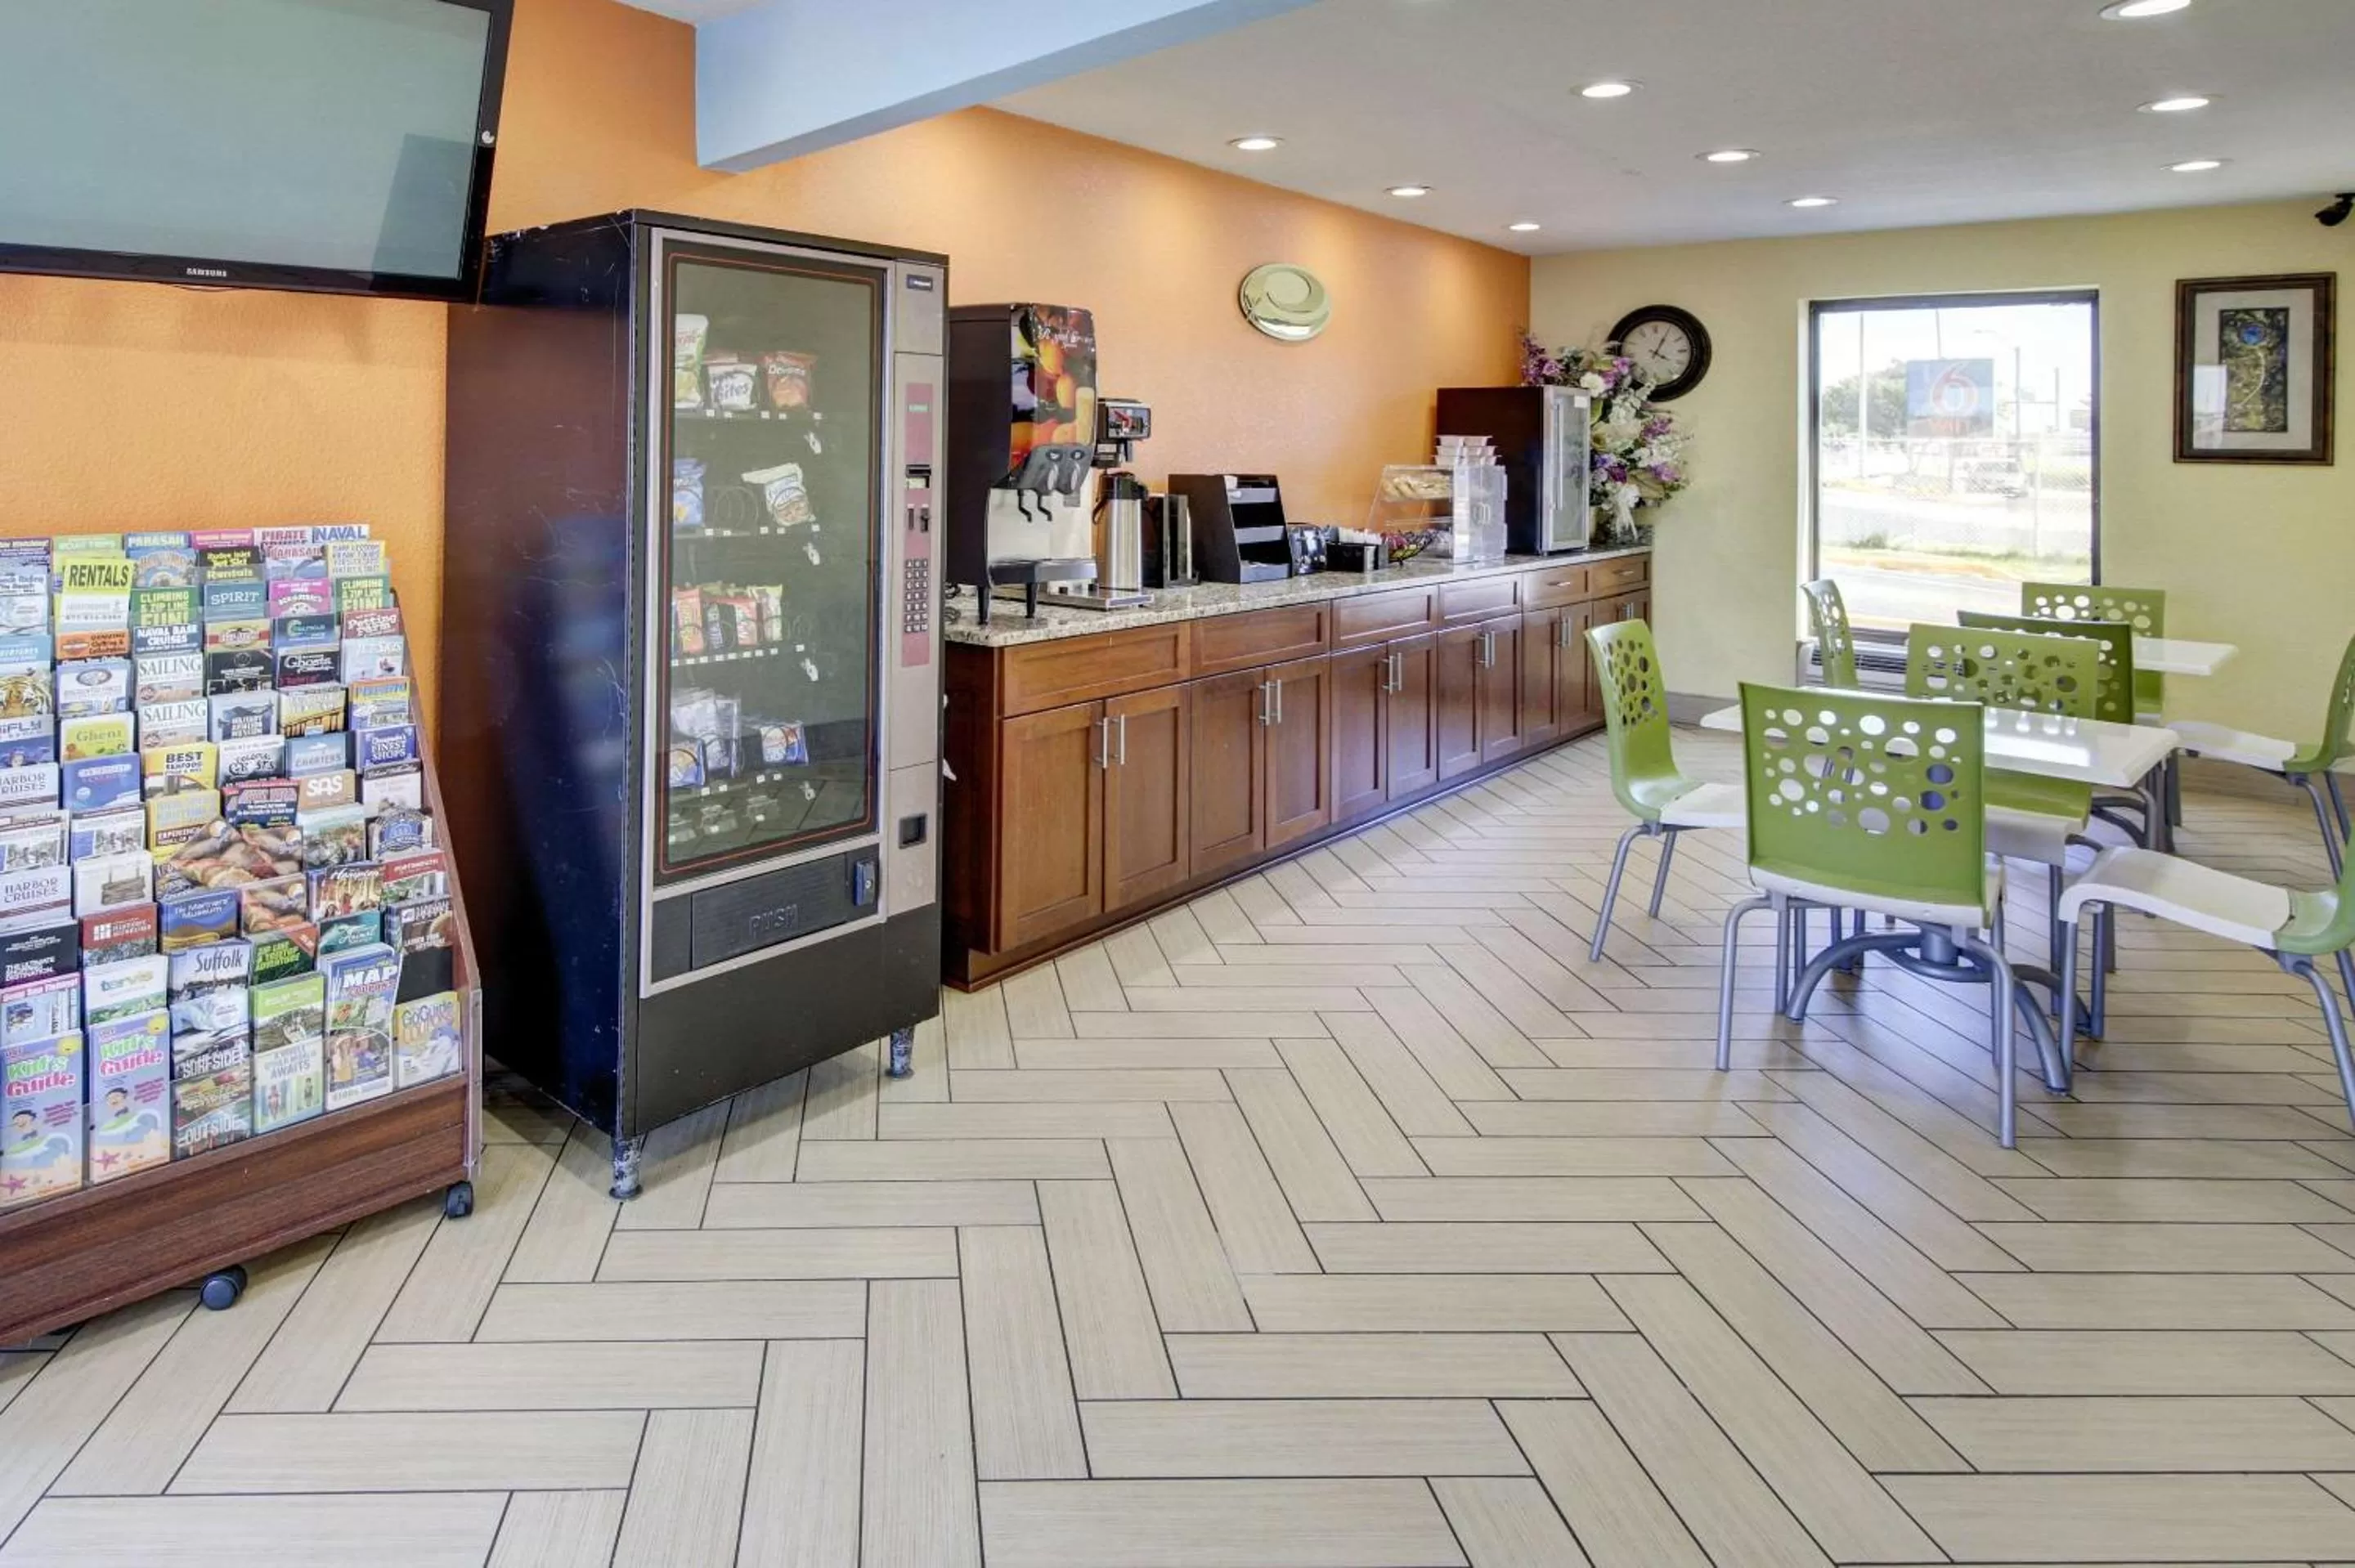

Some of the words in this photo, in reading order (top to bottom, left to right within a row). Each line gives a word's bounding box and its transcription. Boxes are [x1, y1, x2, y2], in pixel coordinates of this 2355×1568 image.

[186, 267, 227, 277] SAMSUNG
[262, 530, 307, 540] PIRATE
[313, 526, 366, 540] NAVAL
[68, 564, 128, 588] RENTALS
[210, 590, 260, 606] SPIRIT
[137, 627, 170, 638] NAVAL
[139, 656, 201, 676] SAILING
[143, 701, 207, 723] SAILING
[165, 750, 204, 764] BEST
[0, 774, 46, 787] ARBOR
[1, 783, 47, 795] RUISES
[4, 877, 59, 894] HARBOR
[4, 888, 59, 903] CRUISES
[749, 903, 799, 939] PUSH
[195, 948, 244, 973] Suffolk
[343, 965, 398, 988] MAP
